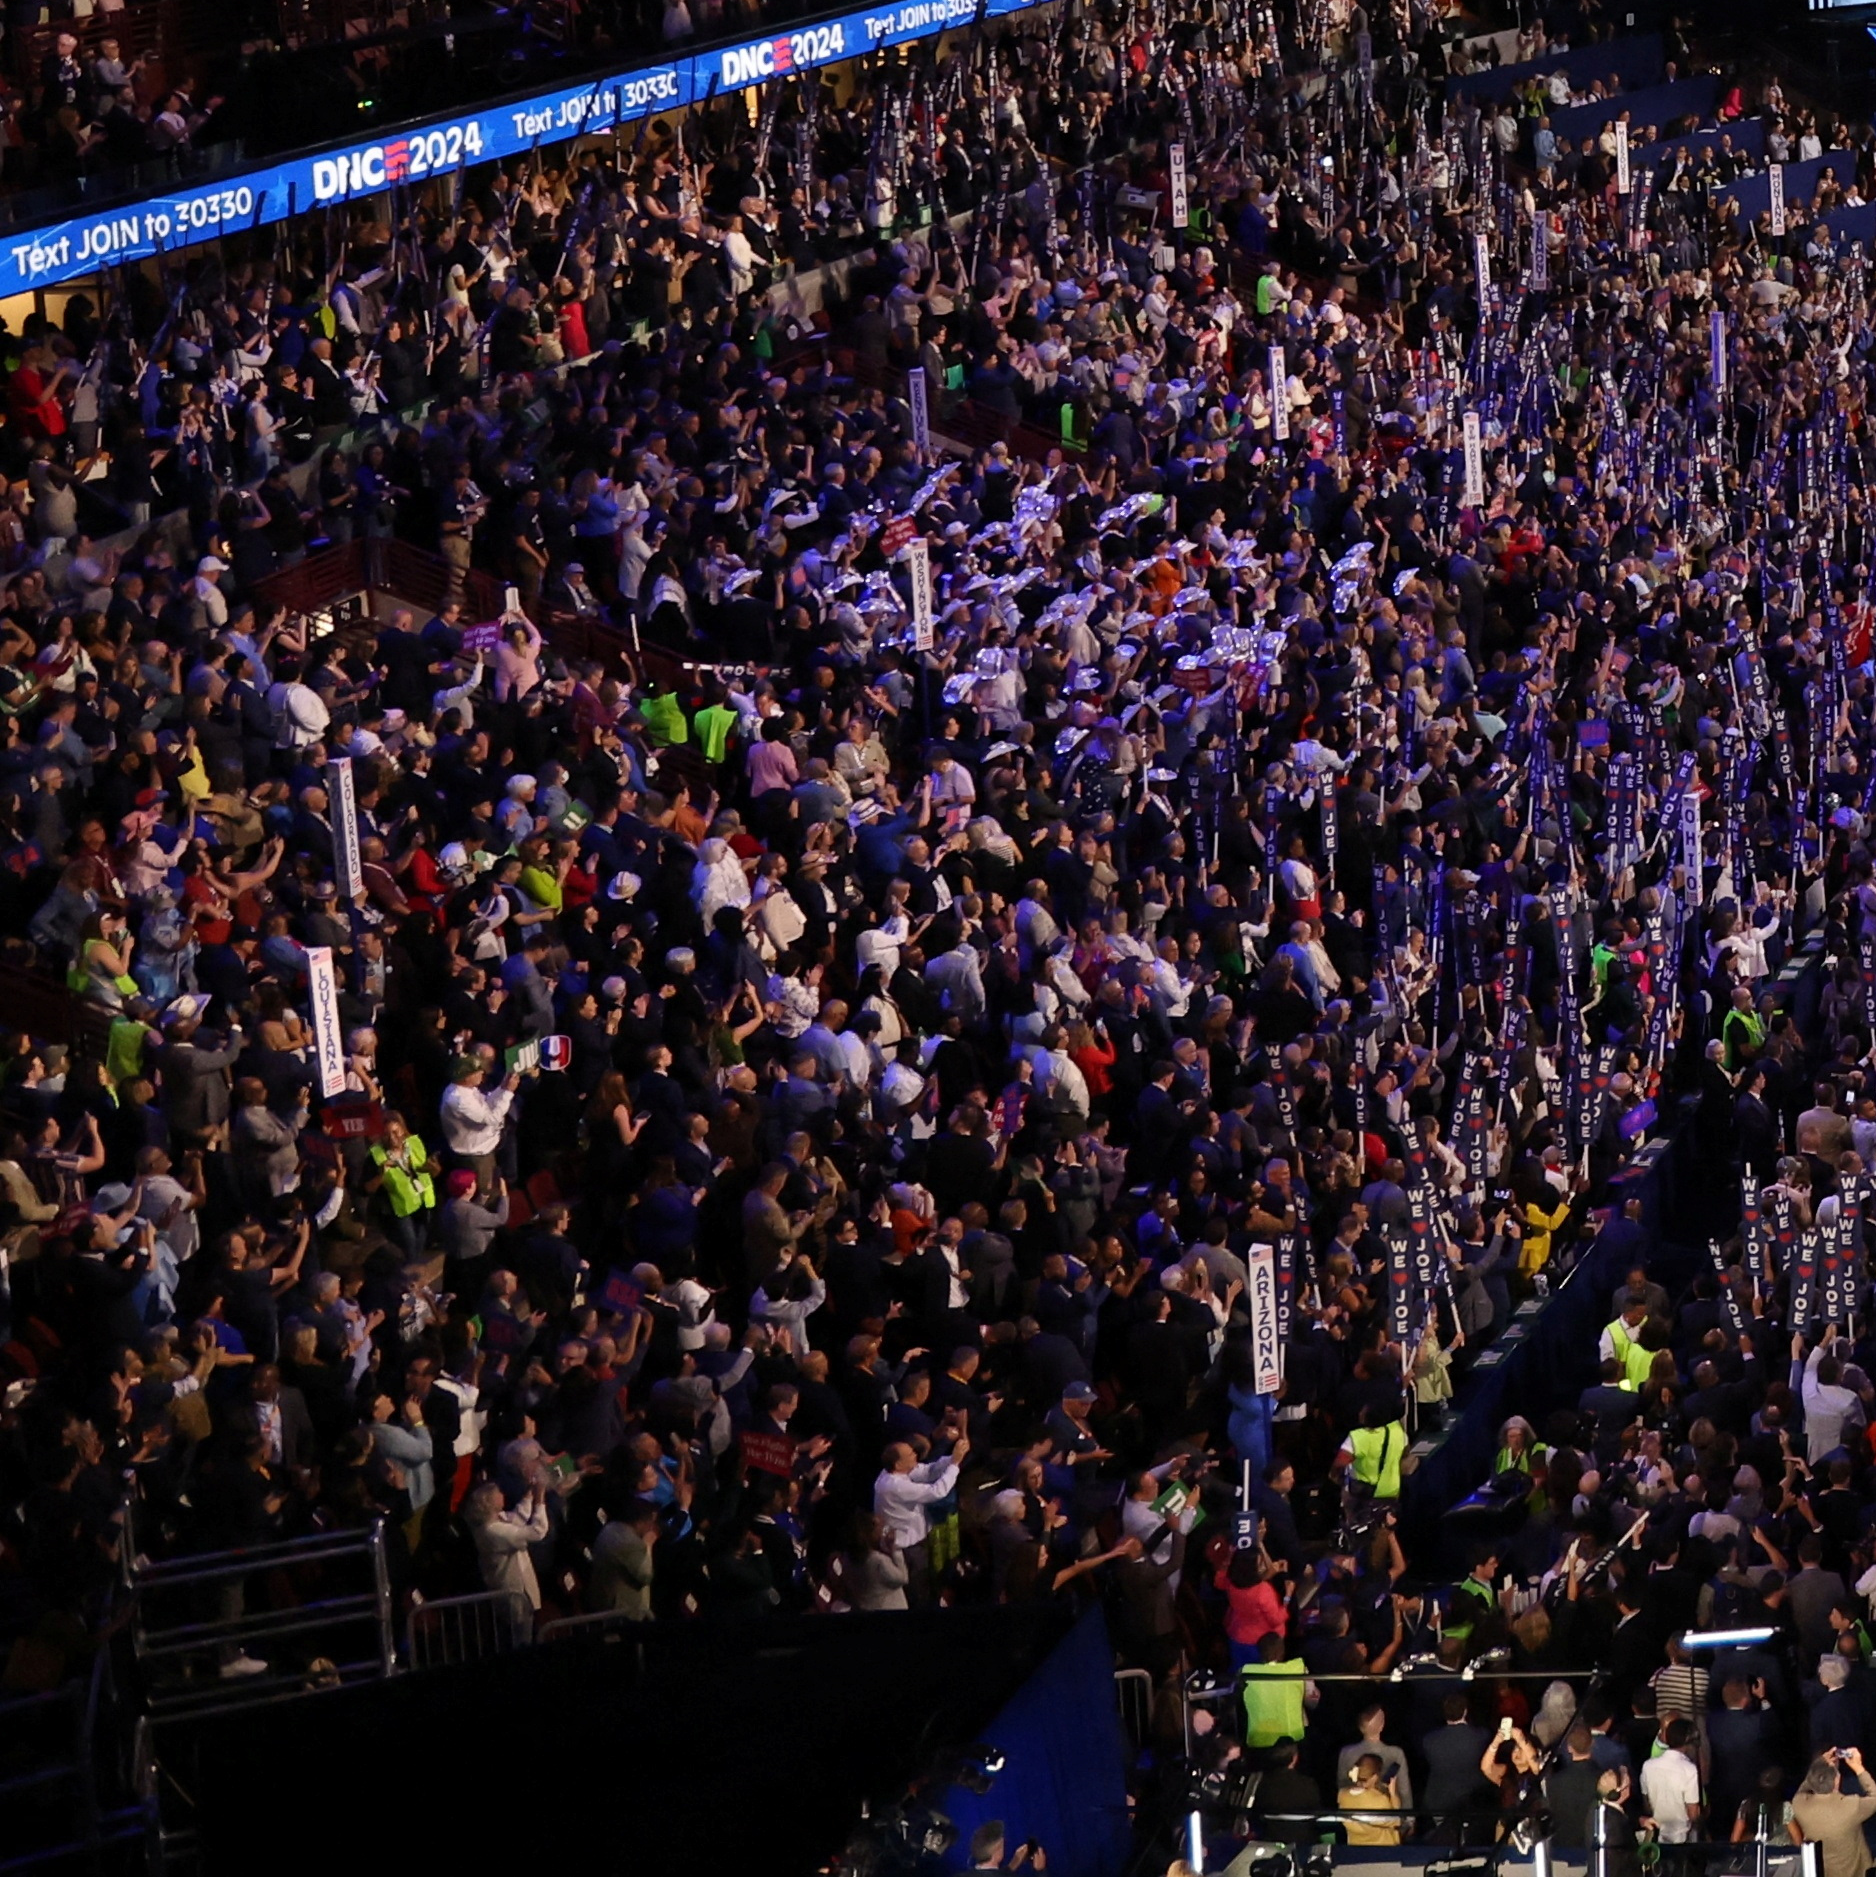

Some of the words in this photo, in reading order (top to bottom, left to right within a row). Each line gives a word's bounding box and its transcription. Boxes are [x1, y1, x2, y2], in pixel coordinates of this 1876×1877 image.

[1173, 155, 1186, 216] UTAH
[1771, 174, 1783, 227] MONTANA
[12, 237, 69, 275] Text
[76, 217, 139, 254] JOIN
[145, 214, 170, 240] to
[175, 187, 251, 231] 30330
[1275, 358, 1287, 426] ALABAMA
[914, 552, 930, 633] WASHINGTON
[1320, 772, 1334, 796] WE
[344, 775, 358, 874] COLORADO
[1324, 813, 1336, 849] JOE
[1685, 808, 1697, 890] OHIO
[318, 968, 339, 1072] LOUISIANA
[514, 1040, 541, 1072] JILL
[1280, 1237, 1294, 1268] WE
[1390, 1239, 1408, 1270] WE
[1254, 1264, 1276, 1372] ARIZONA
[1278, 1291, 1289, 1336] JOE
[1395, 1289, 1409, 1335] JOE
